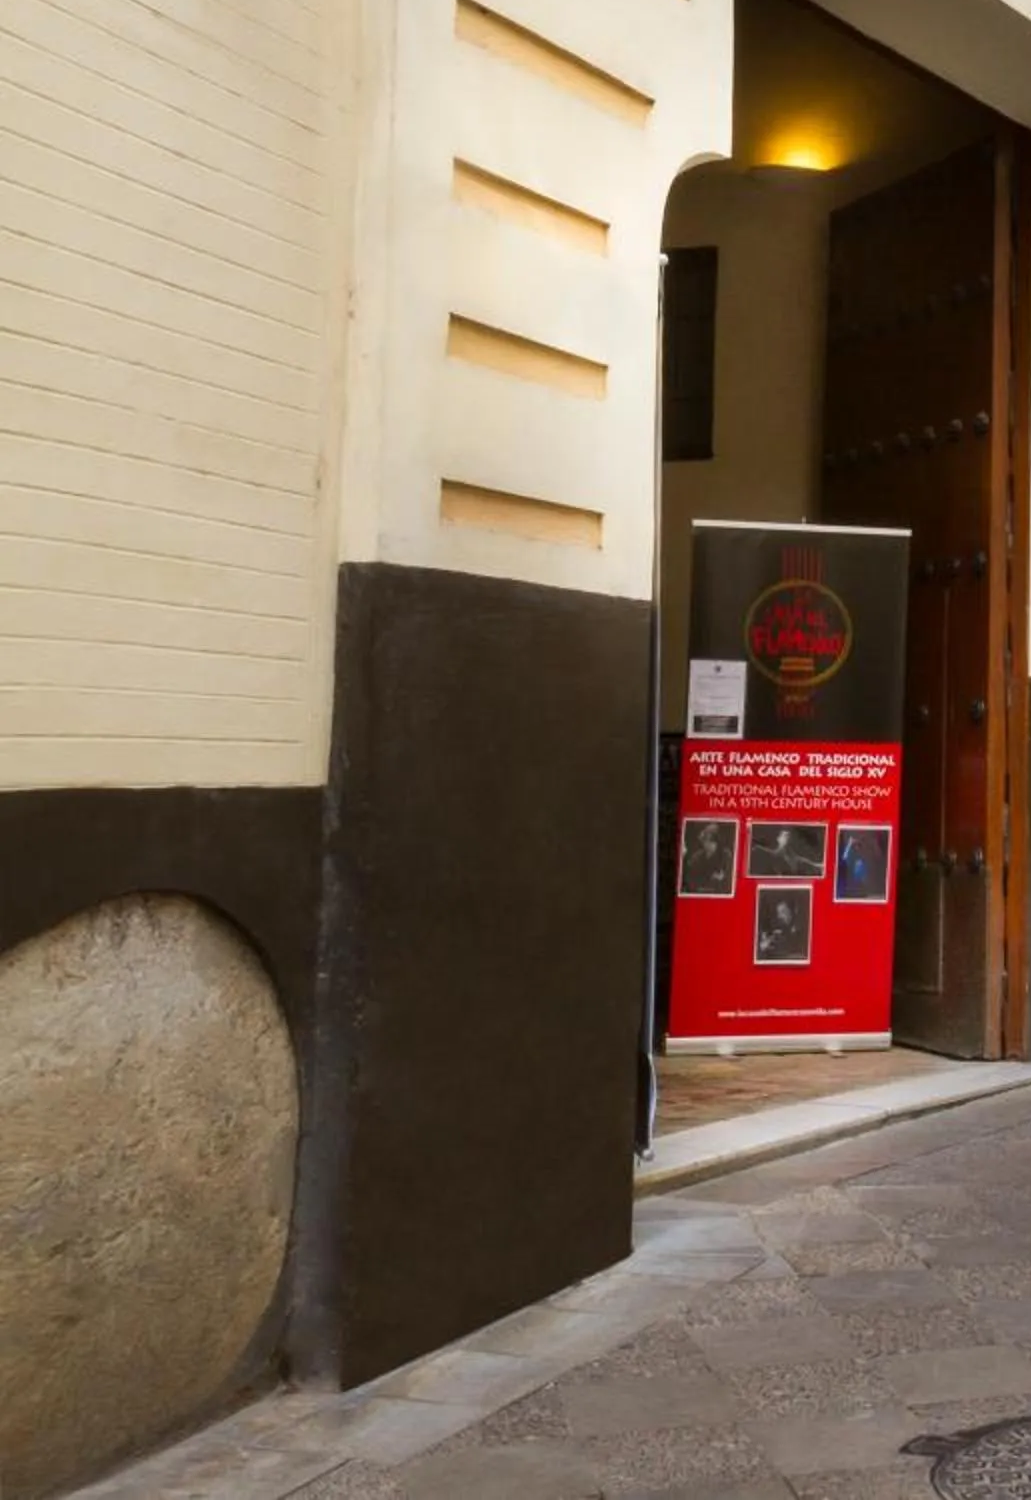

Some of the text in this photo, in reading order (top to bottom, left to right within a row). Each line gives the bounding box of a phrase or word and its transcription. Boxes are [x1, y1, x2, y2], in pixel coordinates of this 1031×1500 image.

[690, 751, 895, 766] ARTE FLAMENCO TRADICIONAL
[699, 765, 886, 779] EN UNA CASA DEL SIGLO XV
[693, 784, 892, 797] TRADITIONAL FLAMENCO SHOW
[709, 797, 724, 808] IN
[727, 797, 737, 808] A
[771, 798, 829, 810] CENTURY
[832, 798, 873, 810] HOUSE
